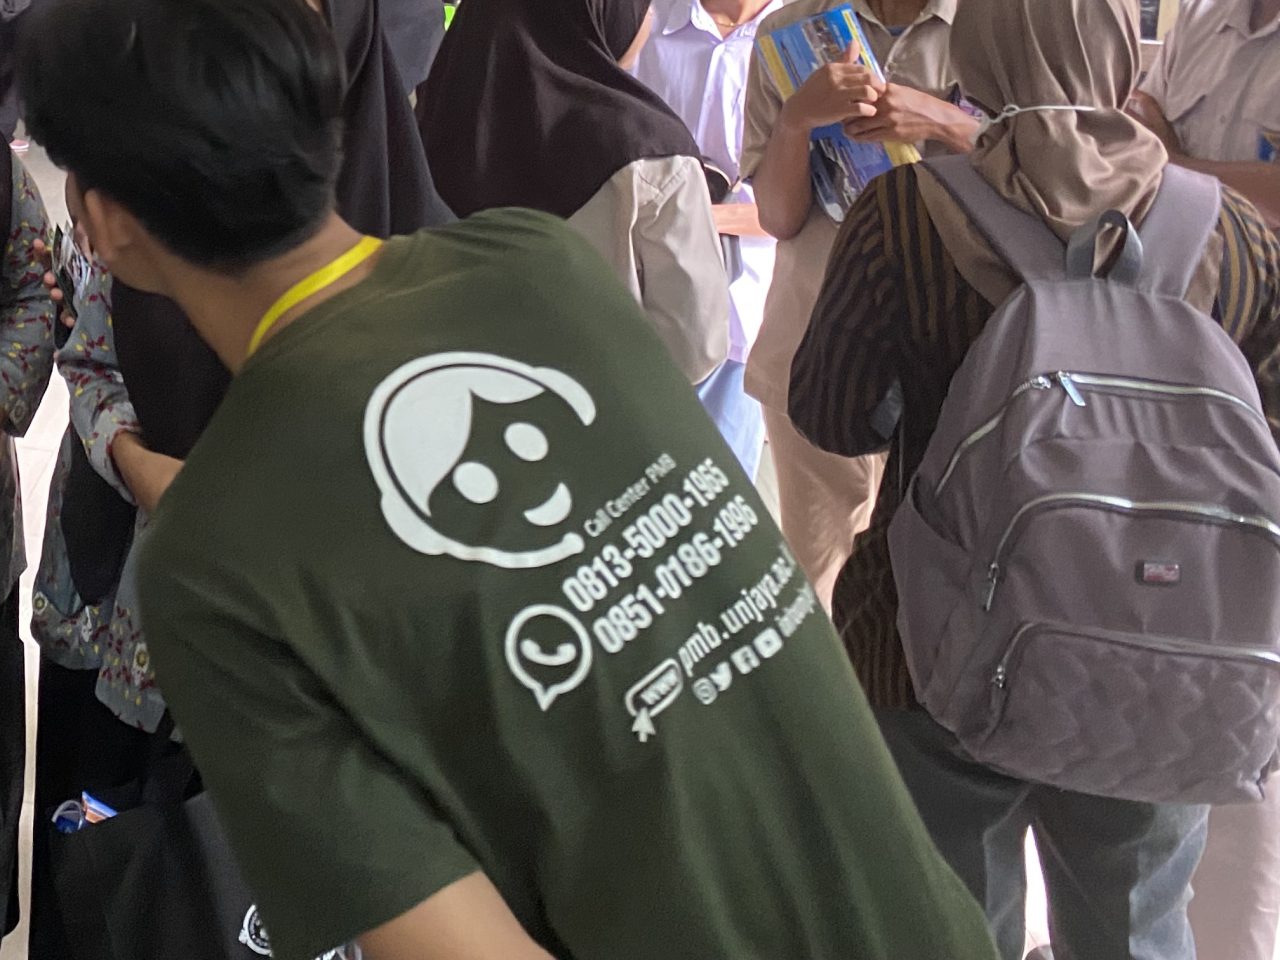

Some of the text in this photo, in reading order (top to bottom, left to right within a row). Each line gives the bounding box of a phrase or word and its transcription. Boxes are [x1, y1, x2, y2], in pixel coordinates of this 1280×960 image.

[583, 508, 613, 538] Call
[605, 477, 651, 518] Center
[592, 493, 759, 654] 0851-0186-1996
